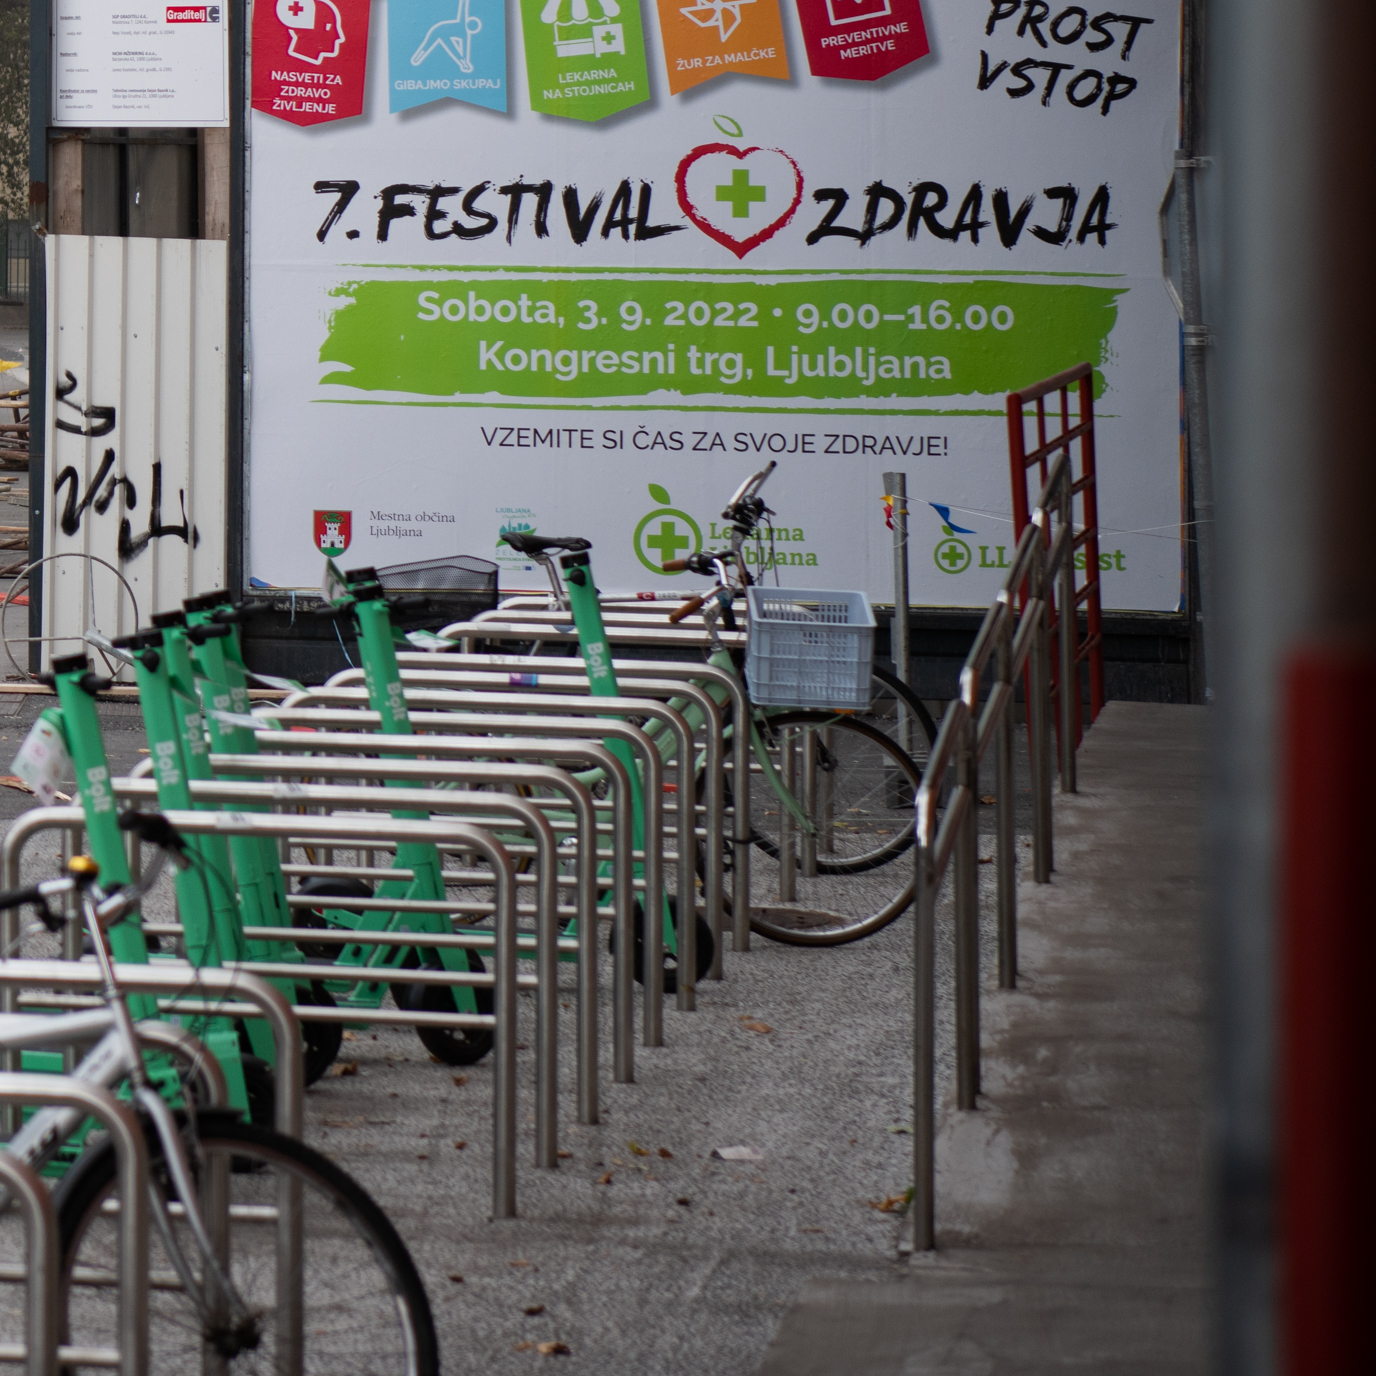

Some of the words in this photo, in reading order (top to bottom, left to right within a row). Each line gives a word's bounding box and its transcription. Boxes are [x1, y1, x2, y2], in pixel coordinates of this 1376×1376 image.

[167, 9, 205, 21] Graditelj
[821, 22, 909, 49] PREVENTIVNE
[676, 57, 703, 71] ŽUR
[706, 55, 721, 67] ZA
[723, 47, 776, 65] MALČKE
[840, 39, 896, 60] MERITVE
[271, 71, 323, 84] NASVETI
[325, 74, 342, 86] ZA
[394, 79, 450, 91] GIBAJMO
[453, 79, 500, 90] SKUPAJ
[558, 68, 617, 83] LEKARNA
[977, 51, 1139, 117] VSTOP
[280, 86, 330, 99] ZDRAVO
[543, 89, 562, 100] NA
[564, 81, 635, 99] STOJNICAH
[272, 99, 336, 114] ŽIVLJENJE
[376, 179, 689, 243] FESTIVAL
[804, 180, 1118, 247] ZDRAVJA
[417, 291, 565, 331] Sobota,
[576, 297, 609, 330] 3.
[620, 297, 652, 335] 9.
[664, 297, 759, 329] 2022
[479, 341, 677, 382] Kongresni
[687, 348, 755, 384] trg,
[765, 346, 952, 388] Ljubljana
[481, 427, 595, 451] VZEMITE
[603, 428, 626, 451] SI
[632, 422, 686, 452] ČAS
[692, 429, 725, 453] ZA
[733, 429, 818, 455] SVOJE
[824, 431, 950, 457] ZDRAVJE!
[369, 510, 411, 522] Mestna
[414, 511, 455, 523] občina
[369, 526, 423, 539] Ljubljana
[709, 523, 805, 542] Learna
[584, 641, 607, 678] Bolt
[154, 740, 181, 786] Bolt
[86, 765, 113, 813] Bolt
